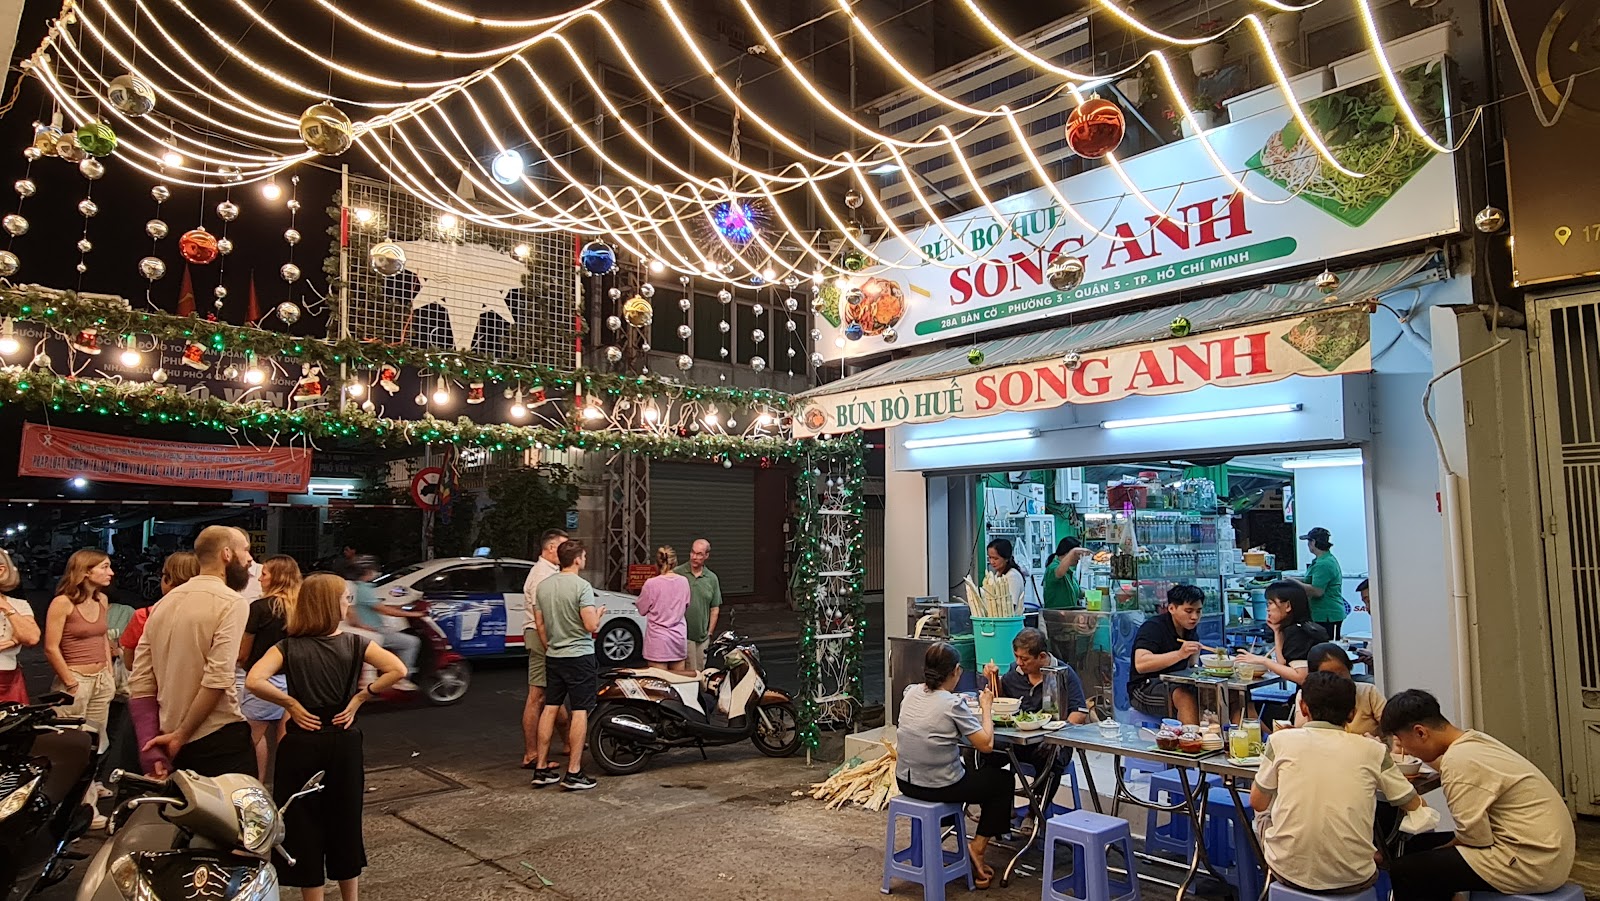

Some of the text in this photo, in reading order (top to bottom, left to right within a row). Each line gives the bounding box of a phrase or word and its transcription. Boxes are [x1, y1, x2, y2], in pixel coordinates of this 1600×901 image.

[920, 195, 1067, 267] BÚN BÒ HUẾ
[950, 190, 1252, 307] SONG ANH
[940, 317, 957, 328] 28A
[961, 311, 980, 324] BÀN
[1008, 297, 1052, 314] PHƯỜNG
[1056, 293, 1063, 303] 3
[1074, 283, 1109, 299] QUẬN
[1114, 282, 1121, 290] 3
[1134, 275, 1152, 286] TP.
[1180, 259, 1204, 275] CHÍ
[1210, 251, 1249, 269] MINH
[836, 331, 1273, 427] BÚN BÒ HUẾ SONG ANH
